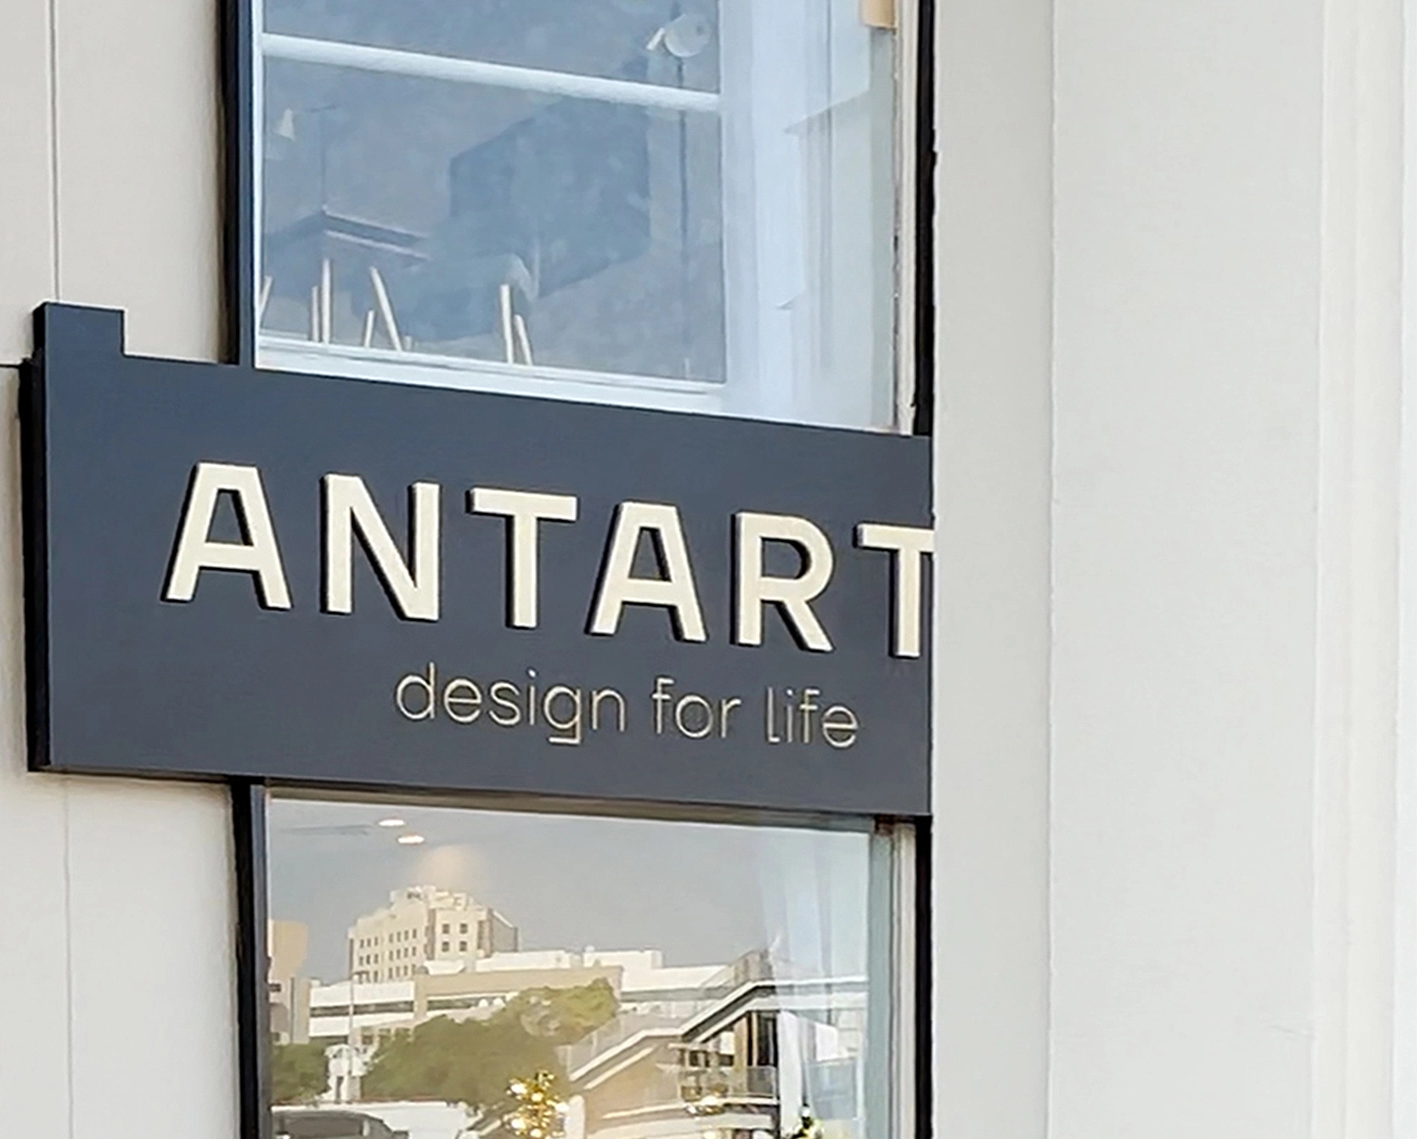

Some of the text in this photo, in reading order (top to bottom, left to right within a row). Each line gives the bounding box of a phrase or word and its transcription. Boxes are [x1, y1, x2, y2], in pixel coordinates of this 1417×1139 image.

[161, 460, 934, 660] ANTART
[395, 662, 859, 748] design for life
